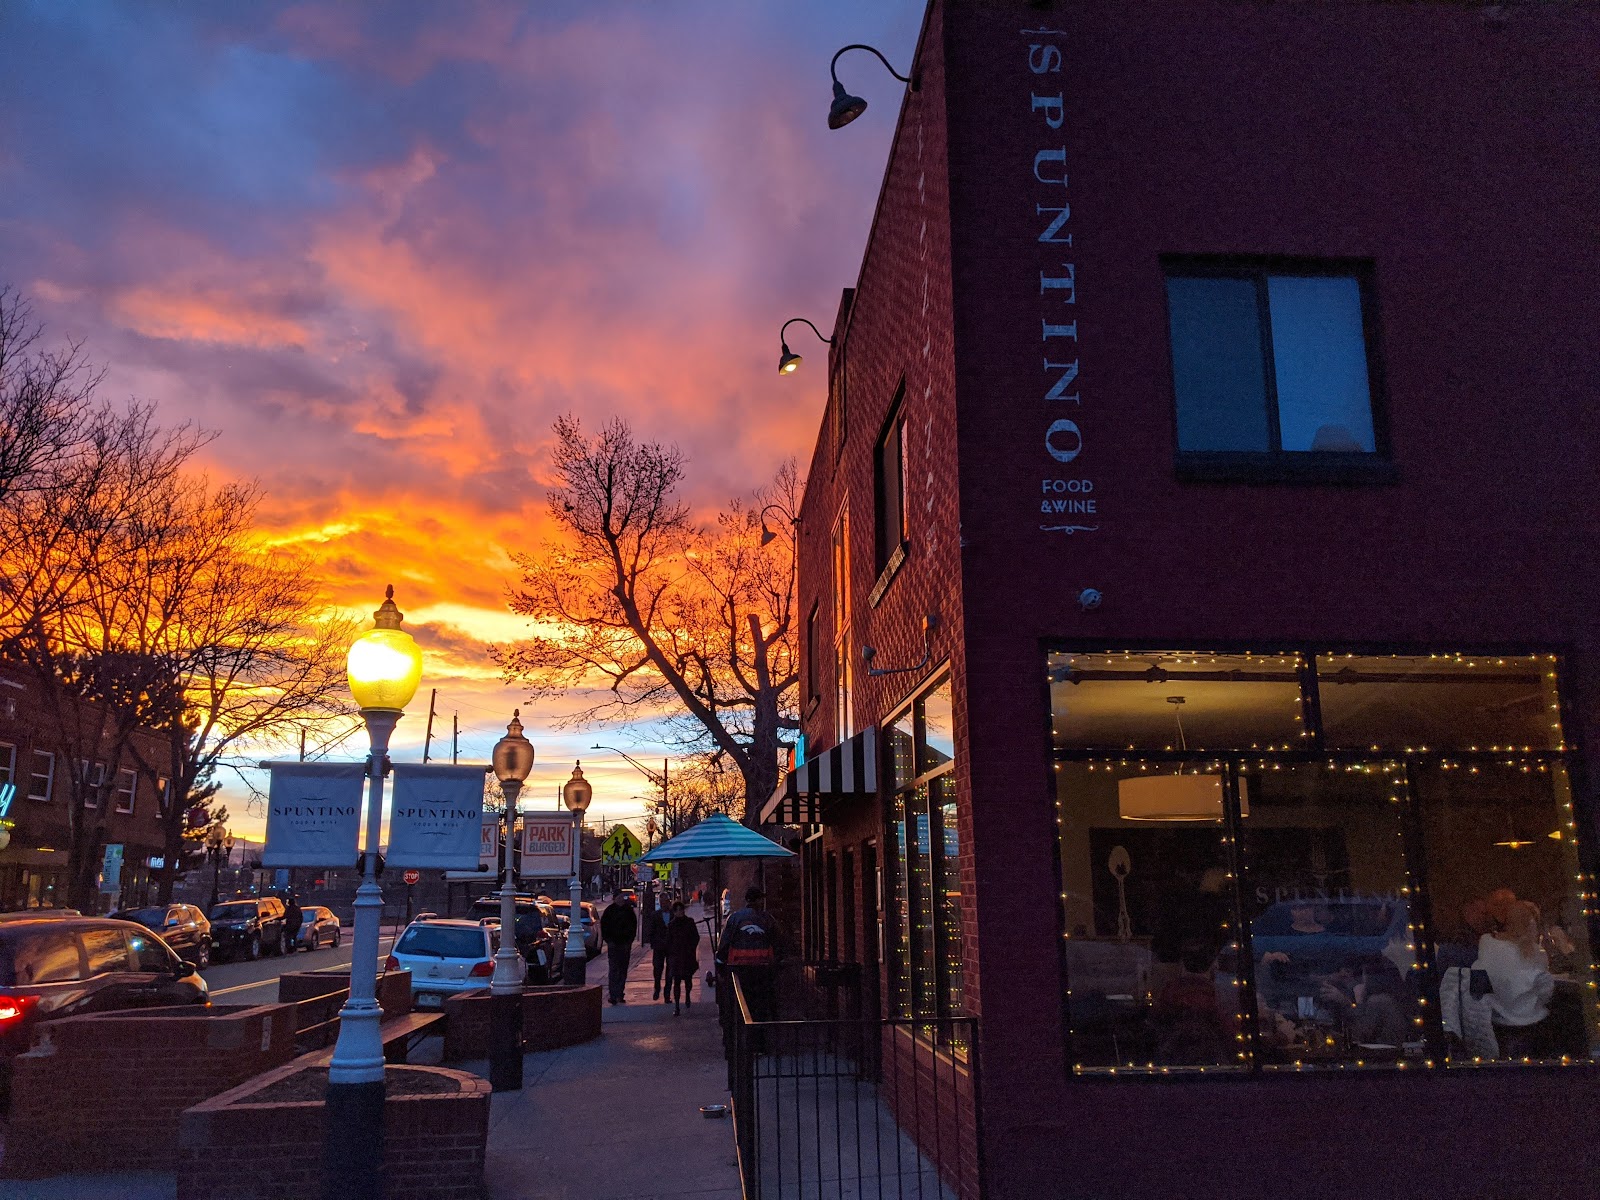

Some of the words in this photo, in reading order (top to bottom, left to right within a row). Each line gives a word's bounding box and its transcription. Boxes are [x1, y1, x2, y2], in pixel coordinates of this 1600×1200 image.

[1028, 43, 1083, 463] SPUNTINO
[1041, 479, 1094, 494] FOOD
[1040, 499, 1097, 514] &WINE
[273, 806, 356, 817] SPUNTINO
[397, 808, 477, 820] SPUNTINO
[529, 826, 566, 842] PARK
[529, 842, 566, 853] BURGER
[404, 872, 418, 881] STOP
